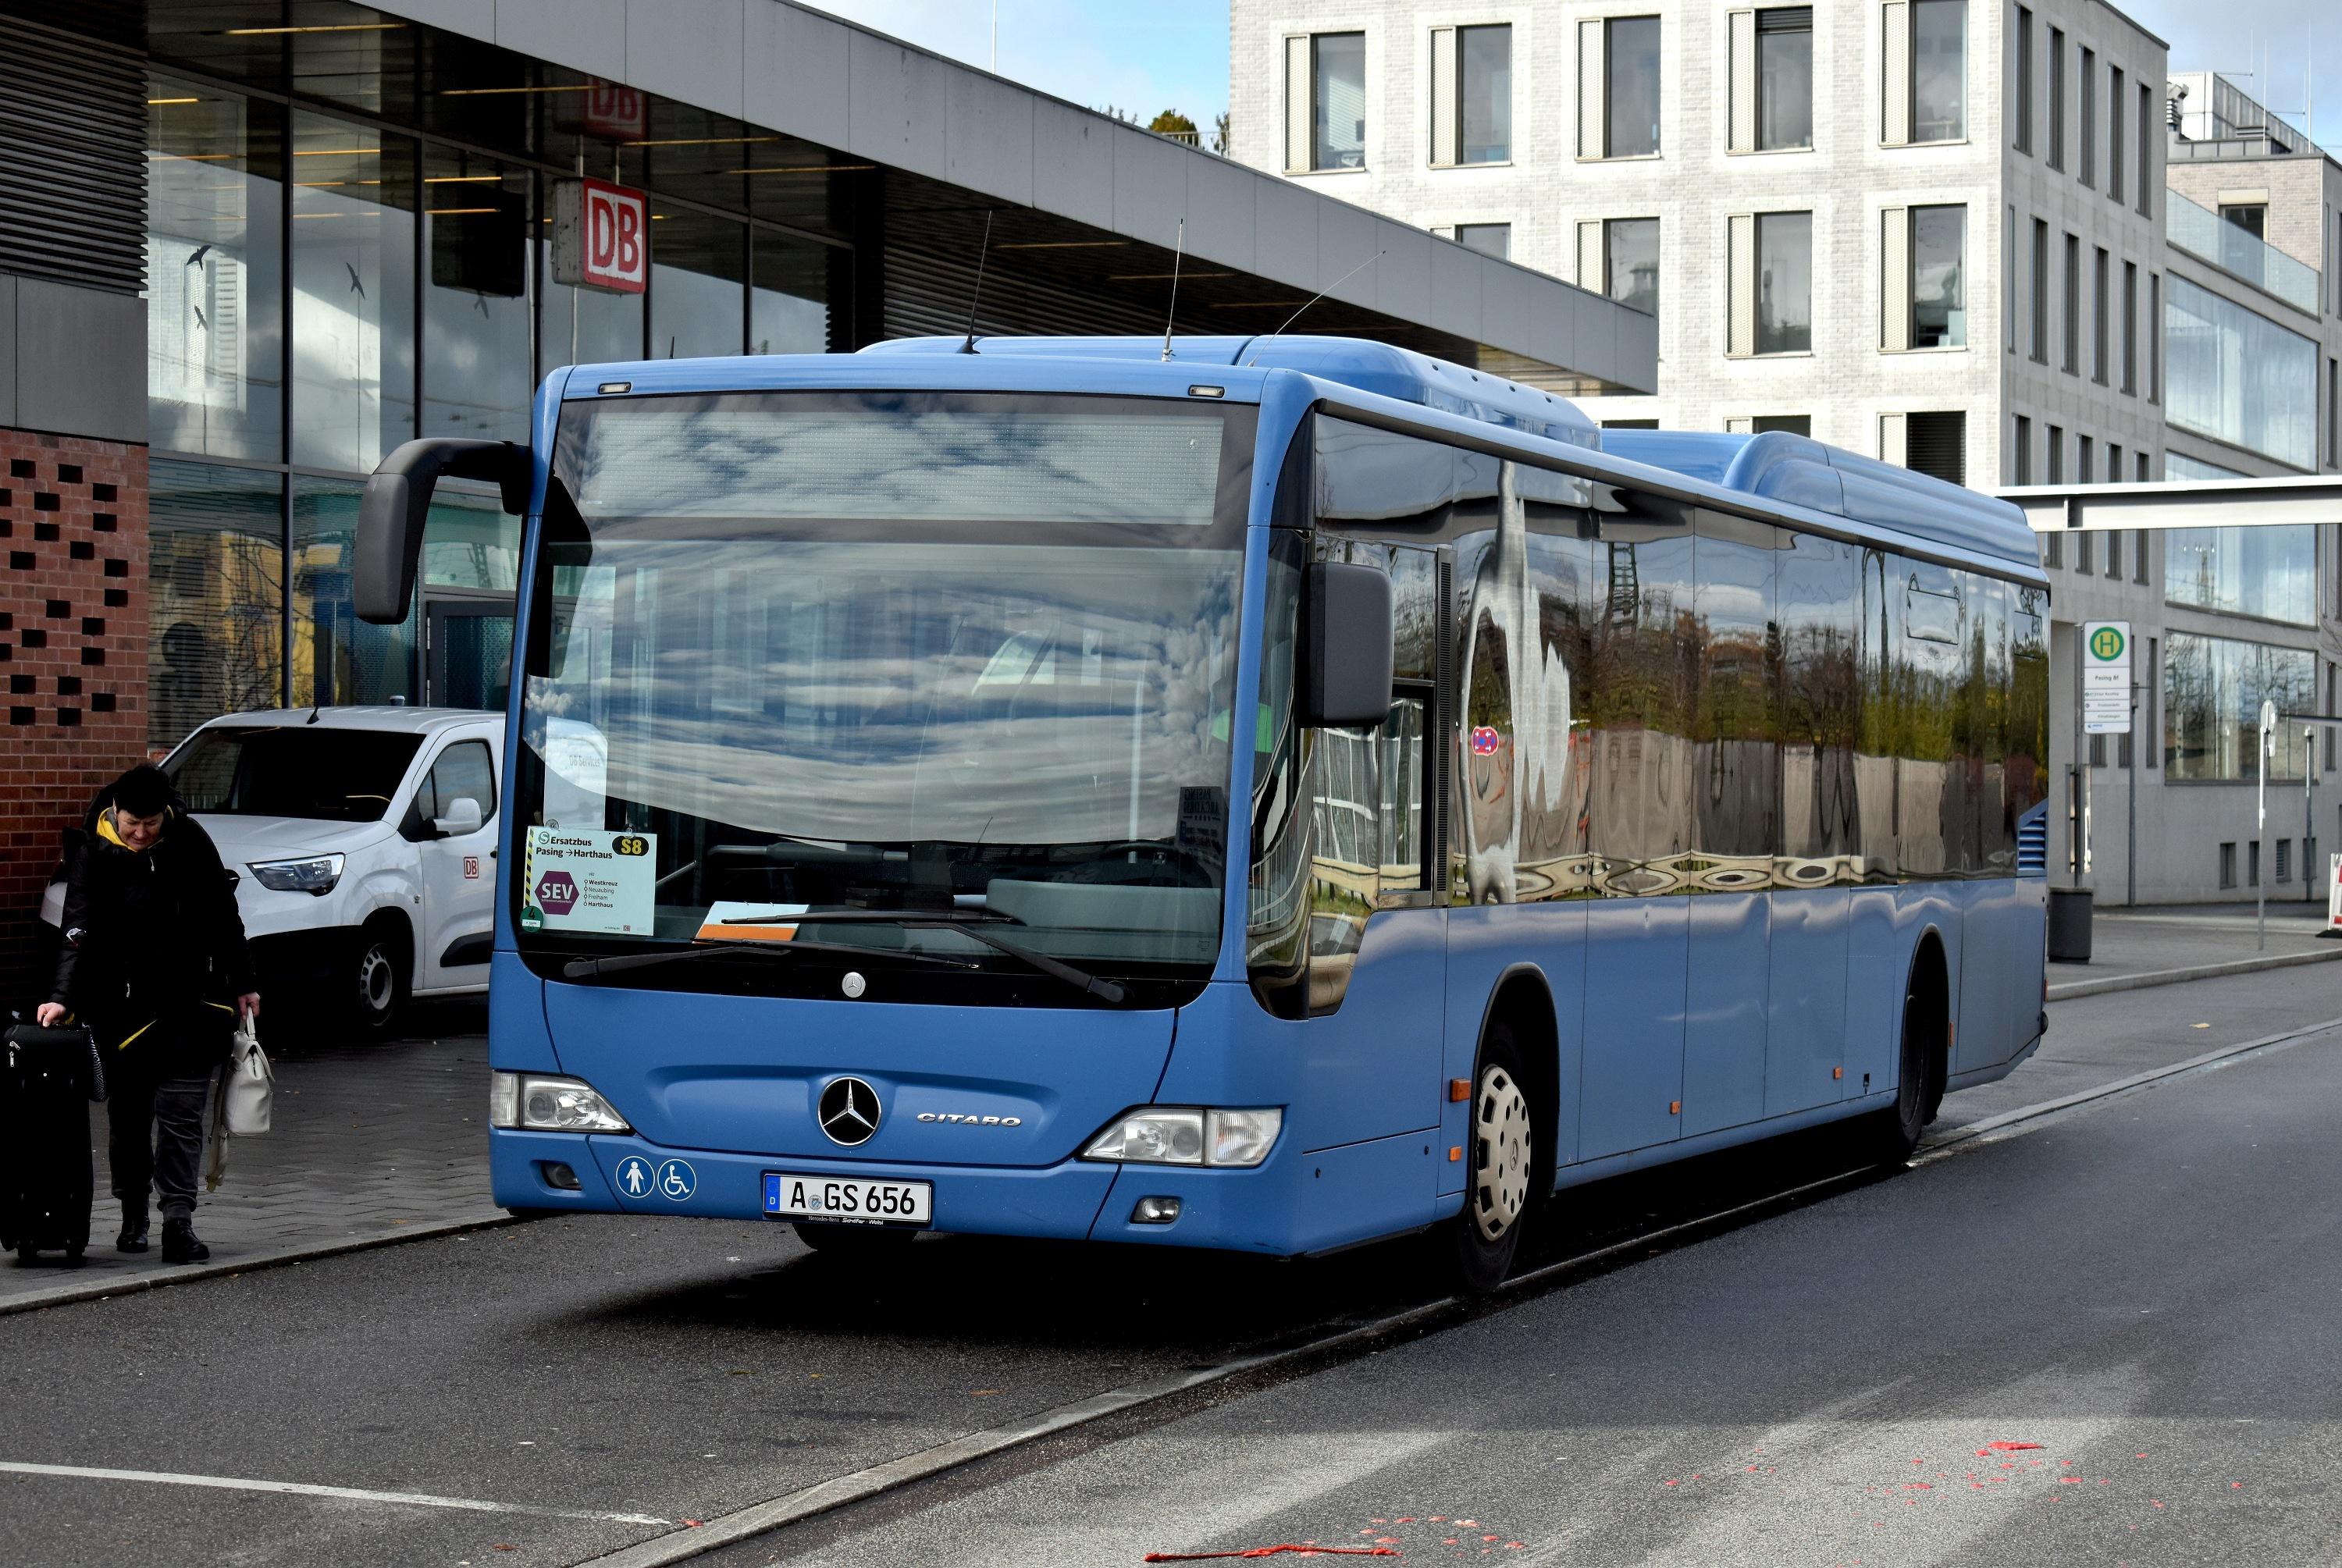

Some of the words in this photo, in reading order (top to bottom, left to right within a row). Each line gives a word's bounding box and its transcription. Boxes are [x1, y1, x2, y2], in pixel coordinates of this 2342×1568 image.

[592, 196, 639, 273] DB
[2100, 635, 2114, 654] H
[578, 755, 600, 767] Services
[550, 837, 592, 846] Ersatzbus
[621, 838, 642, 855] S8
[536, 847, 563, 858] Pasing
[574, 848, 612, 859] Harthaus
[465, 859, 478, 876] DB
[541, 883, 574, 900] SEV
[528, 907, 536, 919] 4
[917, 1112, 1022, 1127] CITARO
[770, 1196, 776, 1205] D
[790, 1181, 806, 1209] A
[824, 1183, 859, 1211] GS
[866, 1186, 915, 1215] 656
